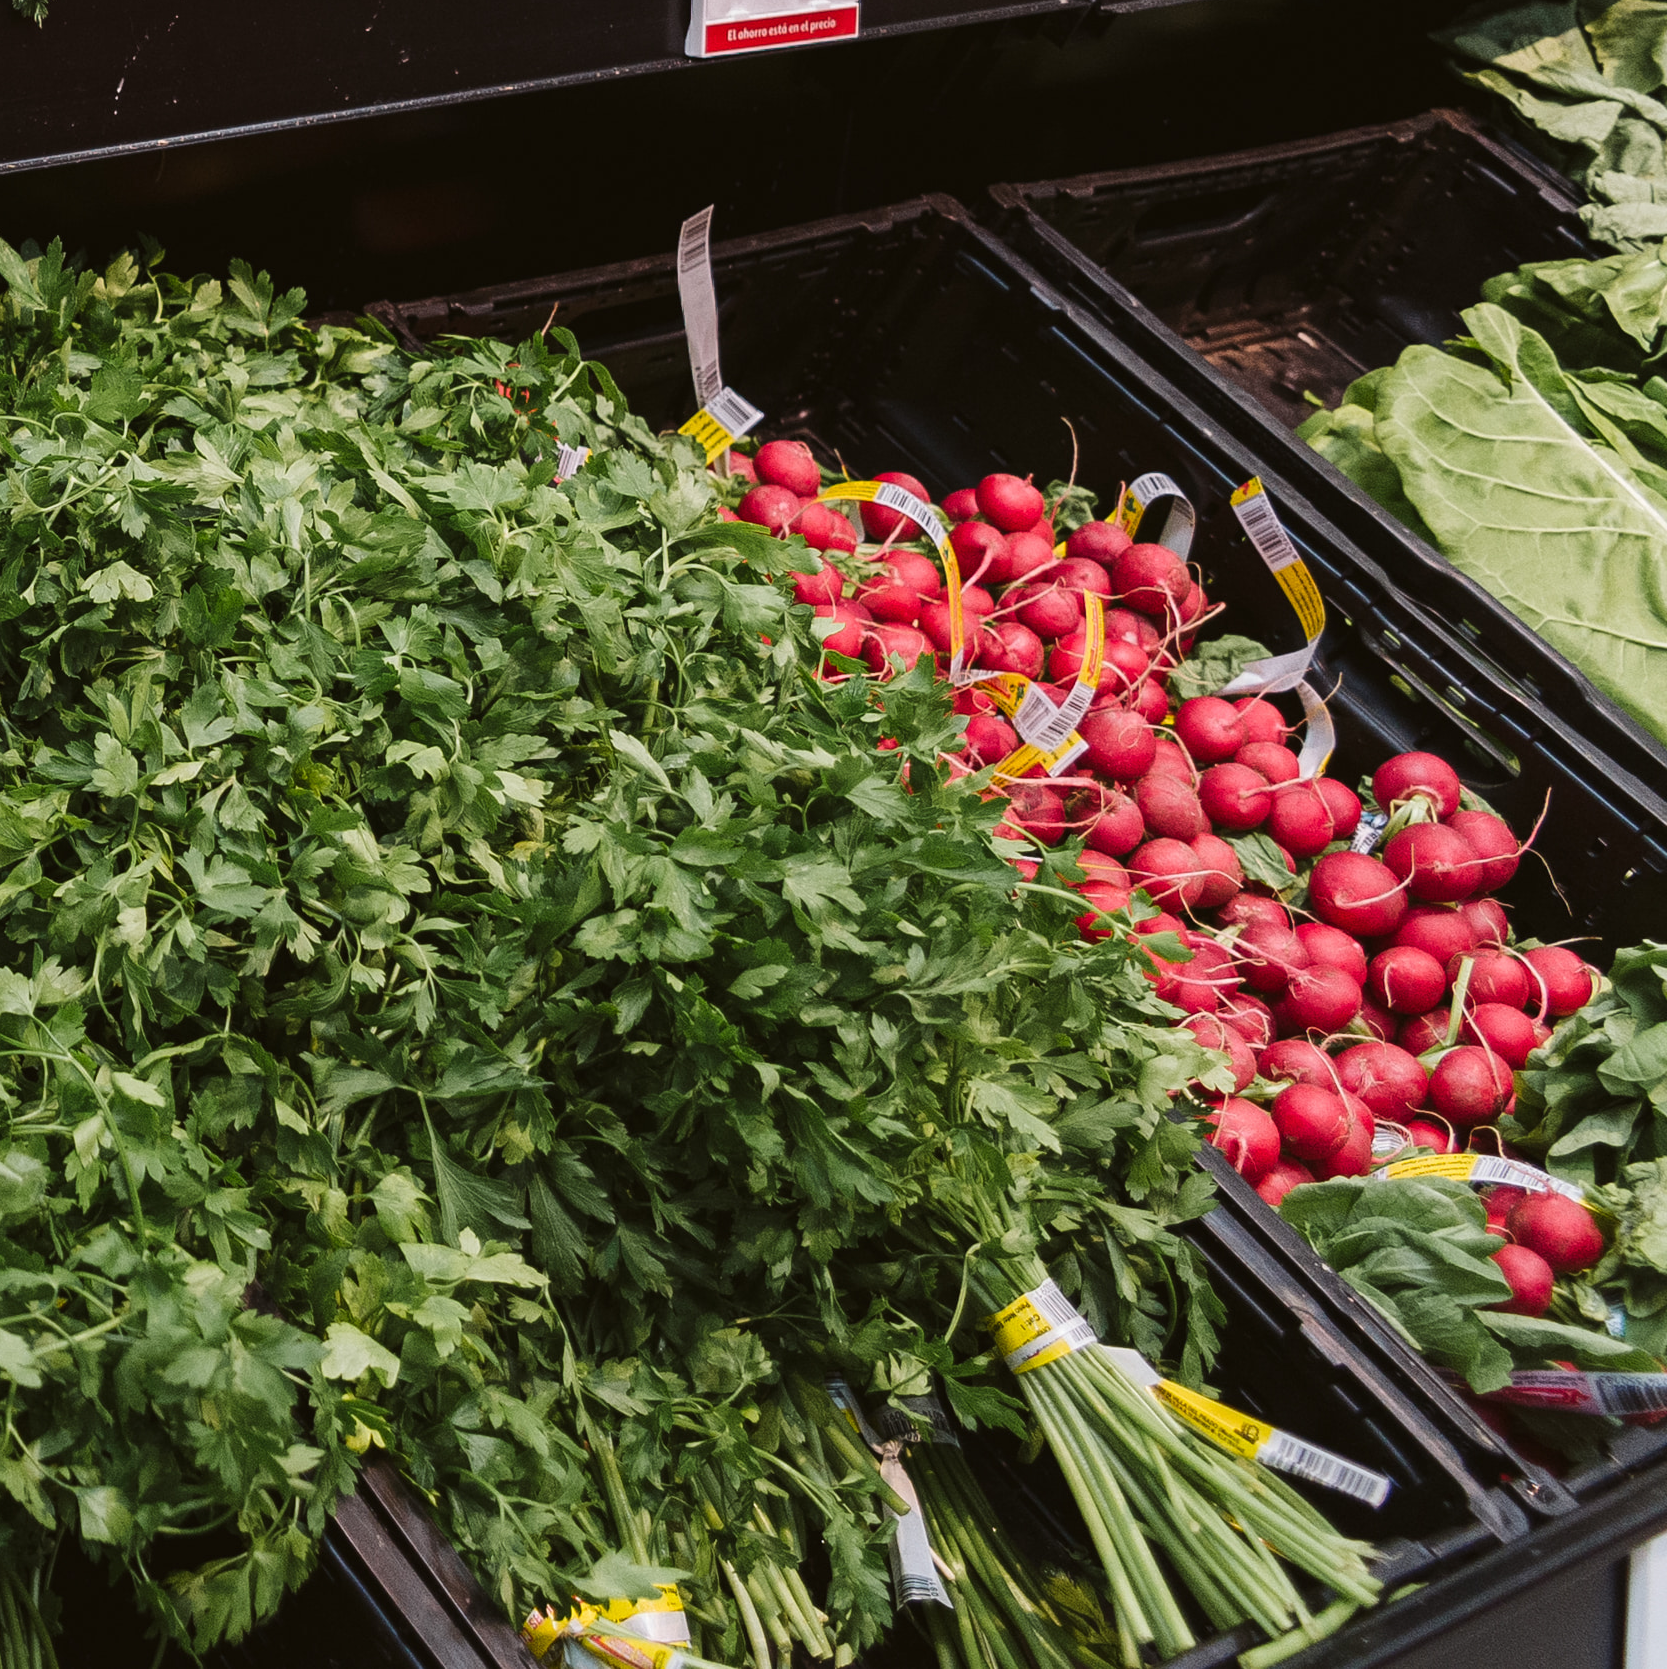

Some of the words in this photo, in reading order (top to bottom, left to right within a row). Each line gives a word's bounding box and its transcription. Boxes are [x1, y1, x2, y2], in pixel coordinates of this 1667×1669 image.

[727, 29, 736, 41] El
[738, 26, 767, 40] ahorro
[768, 22, 787, 36] está
[788, 24, 800, 33] en
[800, 20, 809, 32] el
[810, 17, 836, 33] precio
